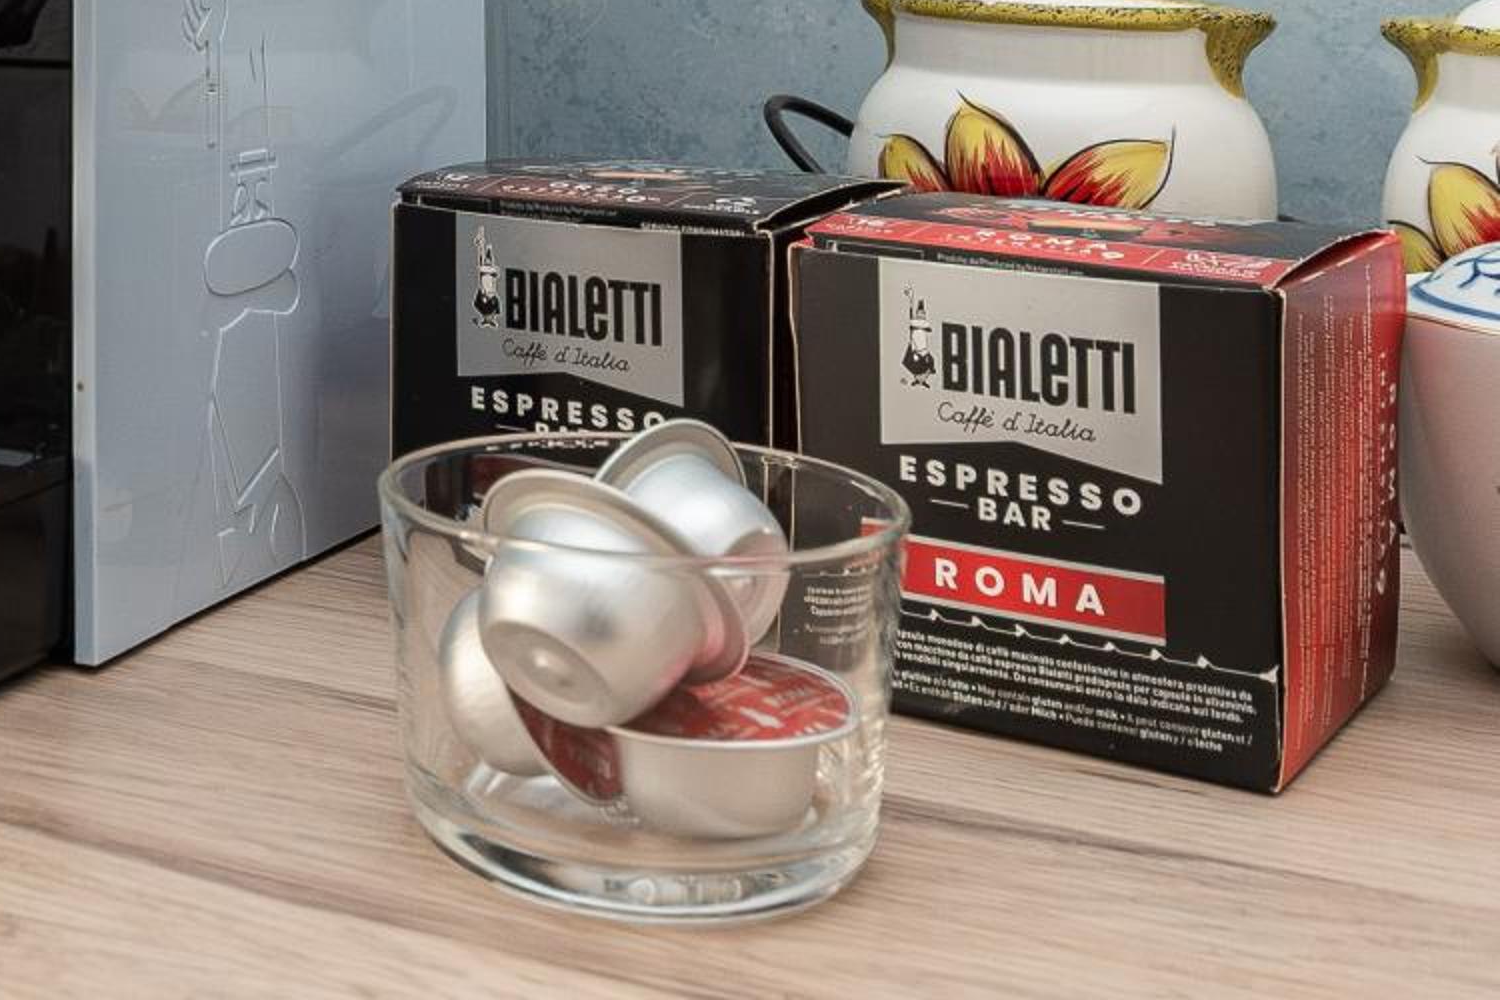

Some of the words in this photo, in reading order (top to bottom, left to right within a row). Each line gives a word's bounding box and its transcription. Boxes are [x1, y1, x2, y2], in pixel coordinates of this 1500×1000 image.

[900, 455, 1142, 516] ESPRESSO
[977, 497, 1051, 531] BAR
[934, 558, 1105, 616] ROMA
